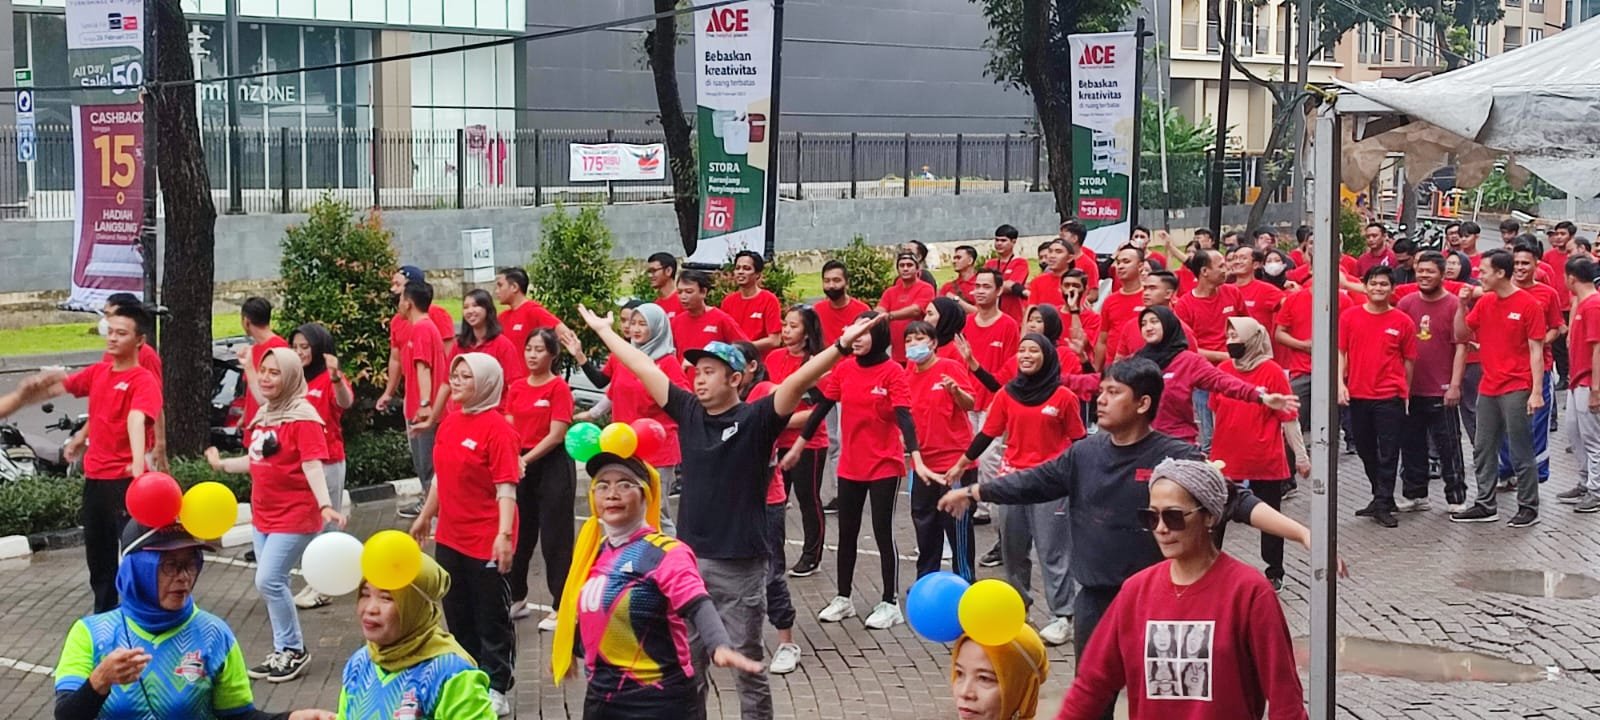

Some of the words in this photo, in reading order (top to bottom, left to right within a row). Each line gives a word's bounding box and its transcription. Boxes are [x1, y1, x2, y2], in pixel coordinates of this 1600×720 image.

[705, 7, 749, 33] ACE
[705, 50, 752, 62] Bebaskan
[1078, 44, 1116, 65] ACE
[73, 65, 87, 79] All
[88, 64, 105, 76] Day
[705, 64, 757, 76] kreativitas
[1078, 79, 1118, 89] Bebaskan
[1078, 90, 1122, 101] kreativitas
[90, 111, 144, 125] CASHBACK
[582, 156, 604, 172] 175
[708, 162, 741, 173] STORA
[1079, 176, 1108, 187] STORA
[102, 209, 134, 221] HADIAH
[1099, 206, 1119, 217] Ribu
[94, 221, 139, 234] LANGSUNG
